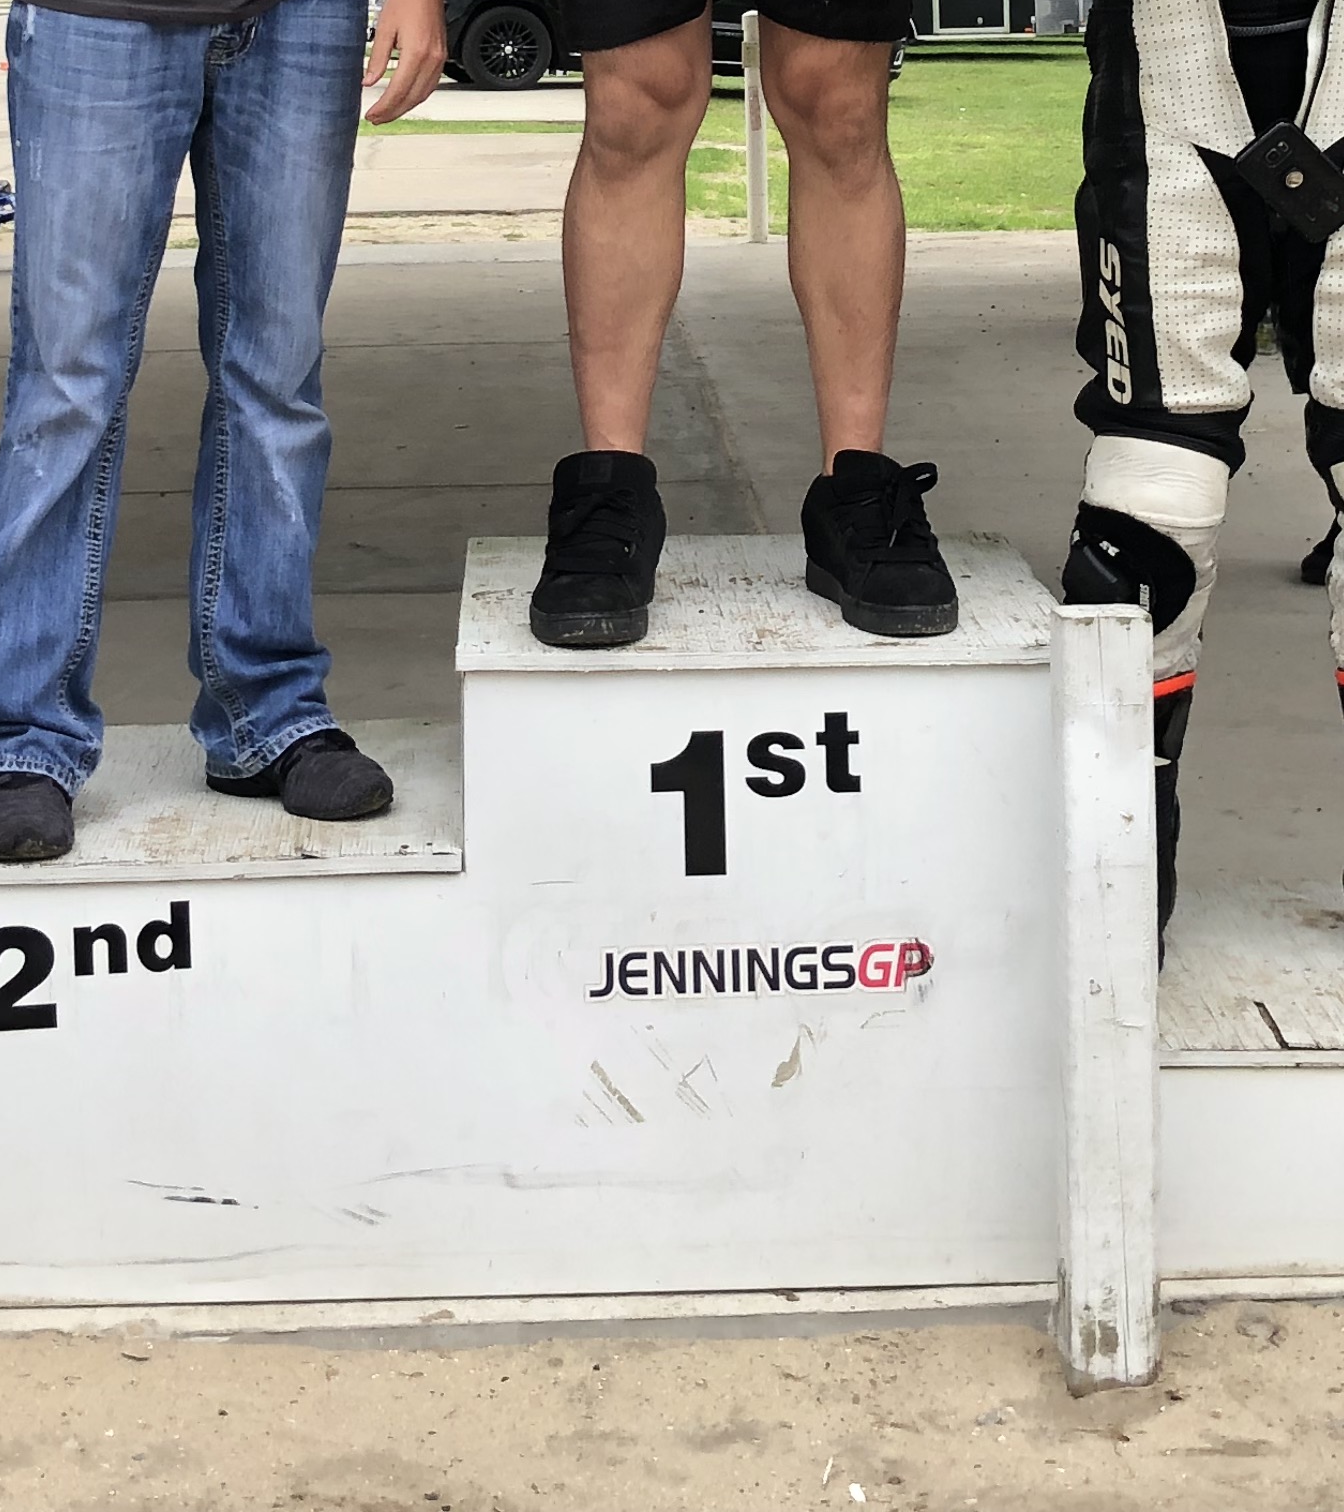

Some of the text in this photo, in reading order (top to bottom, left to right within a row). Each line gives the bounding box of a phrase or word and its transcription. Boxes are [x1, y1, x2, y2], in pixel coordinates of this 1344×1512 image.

[1098, 237, 1134, 405] SYED
[650, 711, 862, 878] 1st
[588, 939, 935, 999] JENNINGSGP
